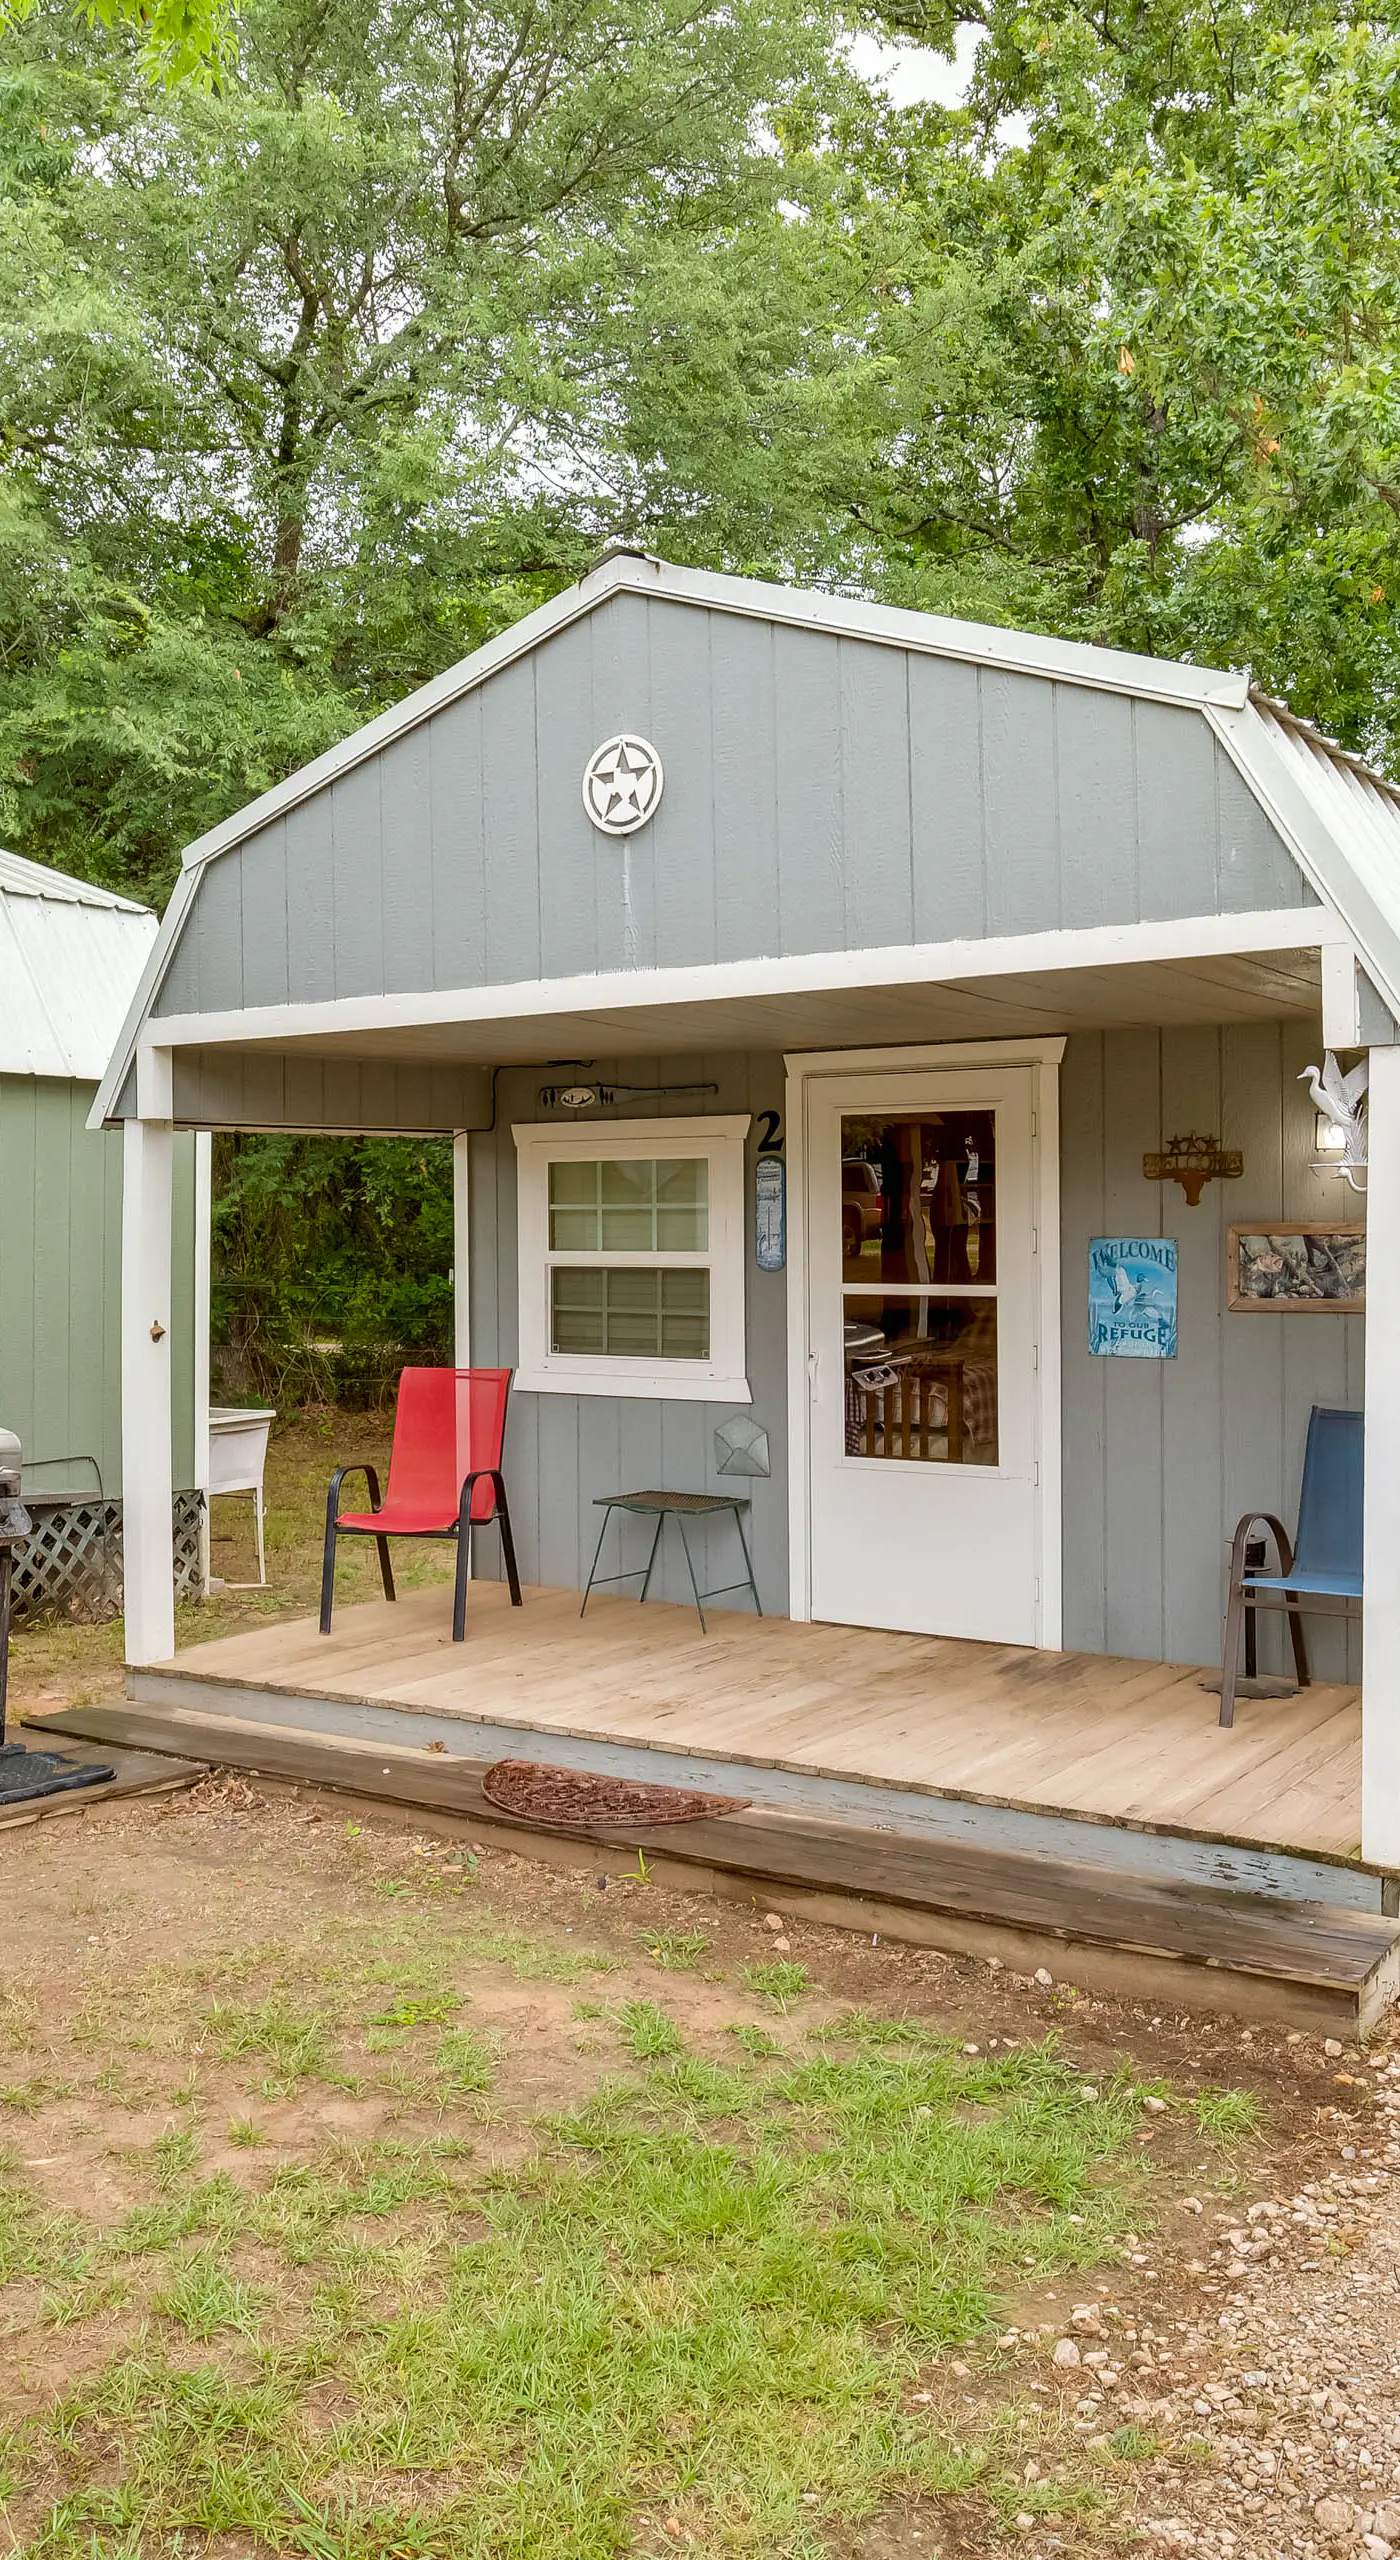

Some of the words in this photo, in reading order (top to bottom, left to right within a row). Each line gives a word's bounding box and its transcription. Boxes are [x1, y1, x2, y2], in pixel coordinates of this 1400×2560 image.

[757, 1110, 785, 1152] 2
[1092, 1241, 1175, 1272] WELCOME
[1098, 1323, 1167, 1347] REFUGE
